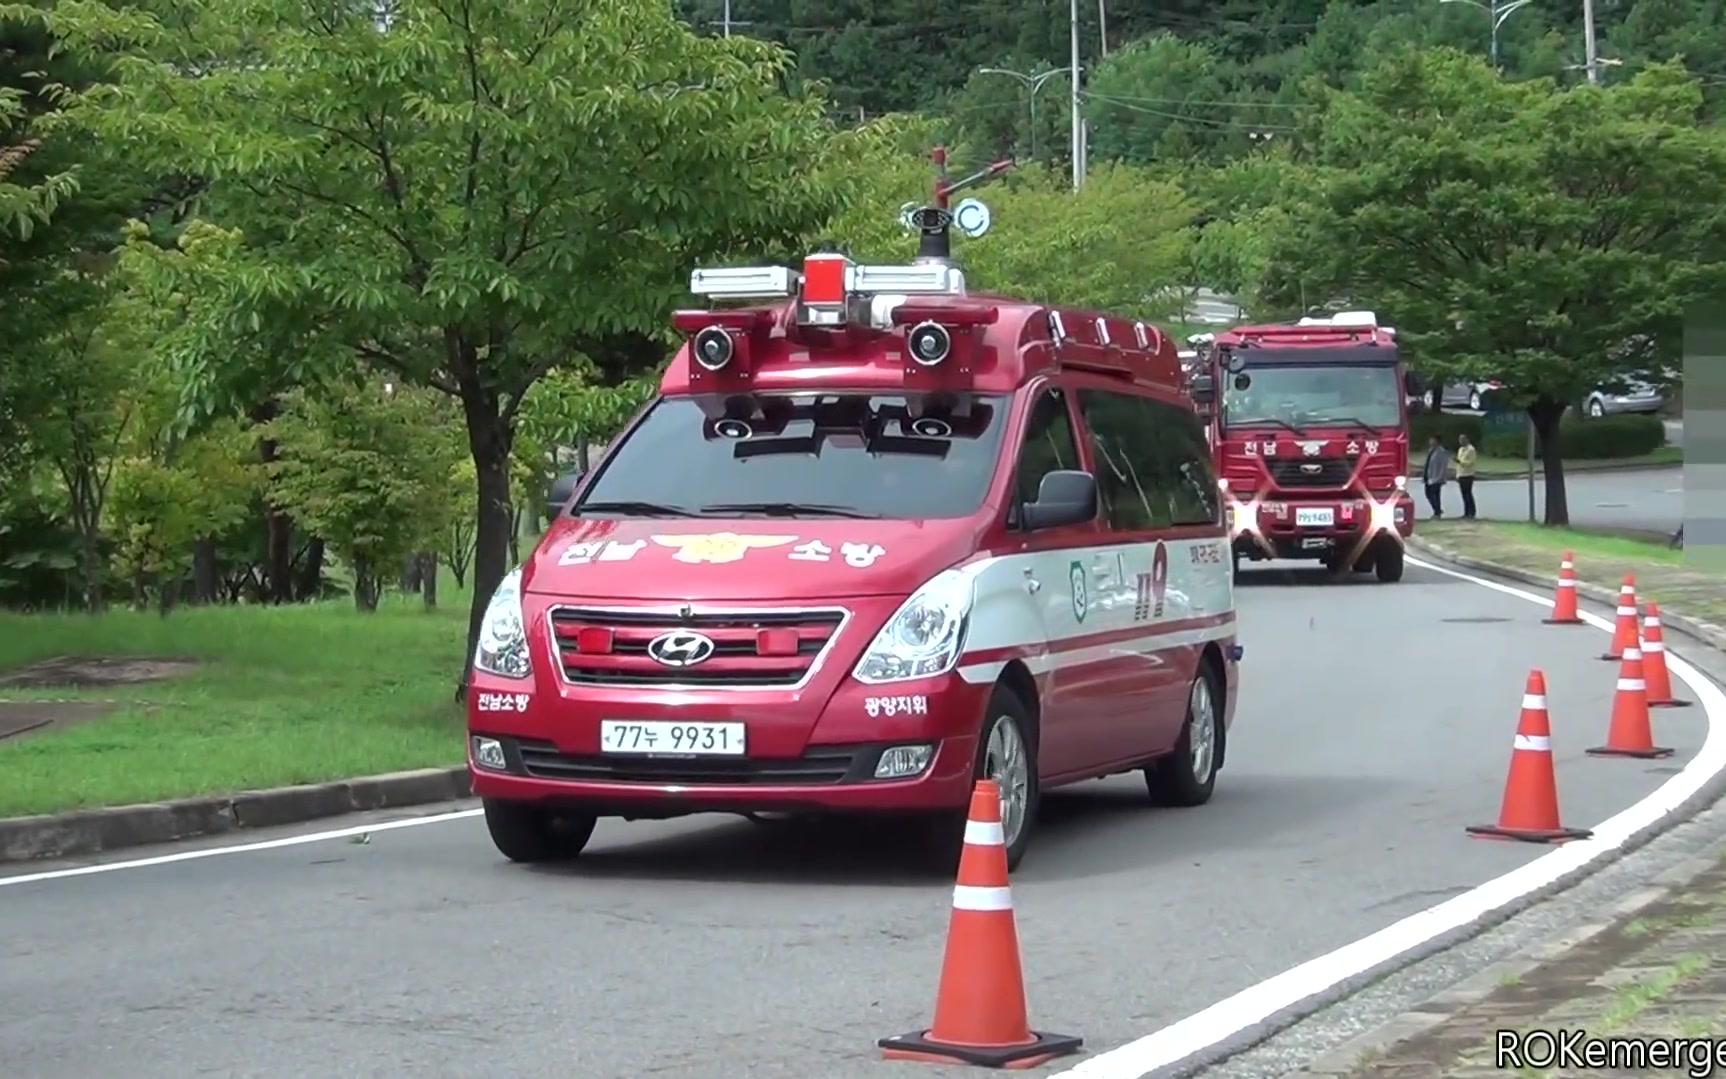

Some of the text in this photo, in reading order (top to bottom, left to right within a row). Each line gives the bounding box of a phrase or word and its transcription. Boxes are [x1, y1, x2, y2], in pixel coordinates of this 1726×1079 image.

[864, 694, 928, 718] 광양지휘
[614, 725, 728, 750] 77누 9931
